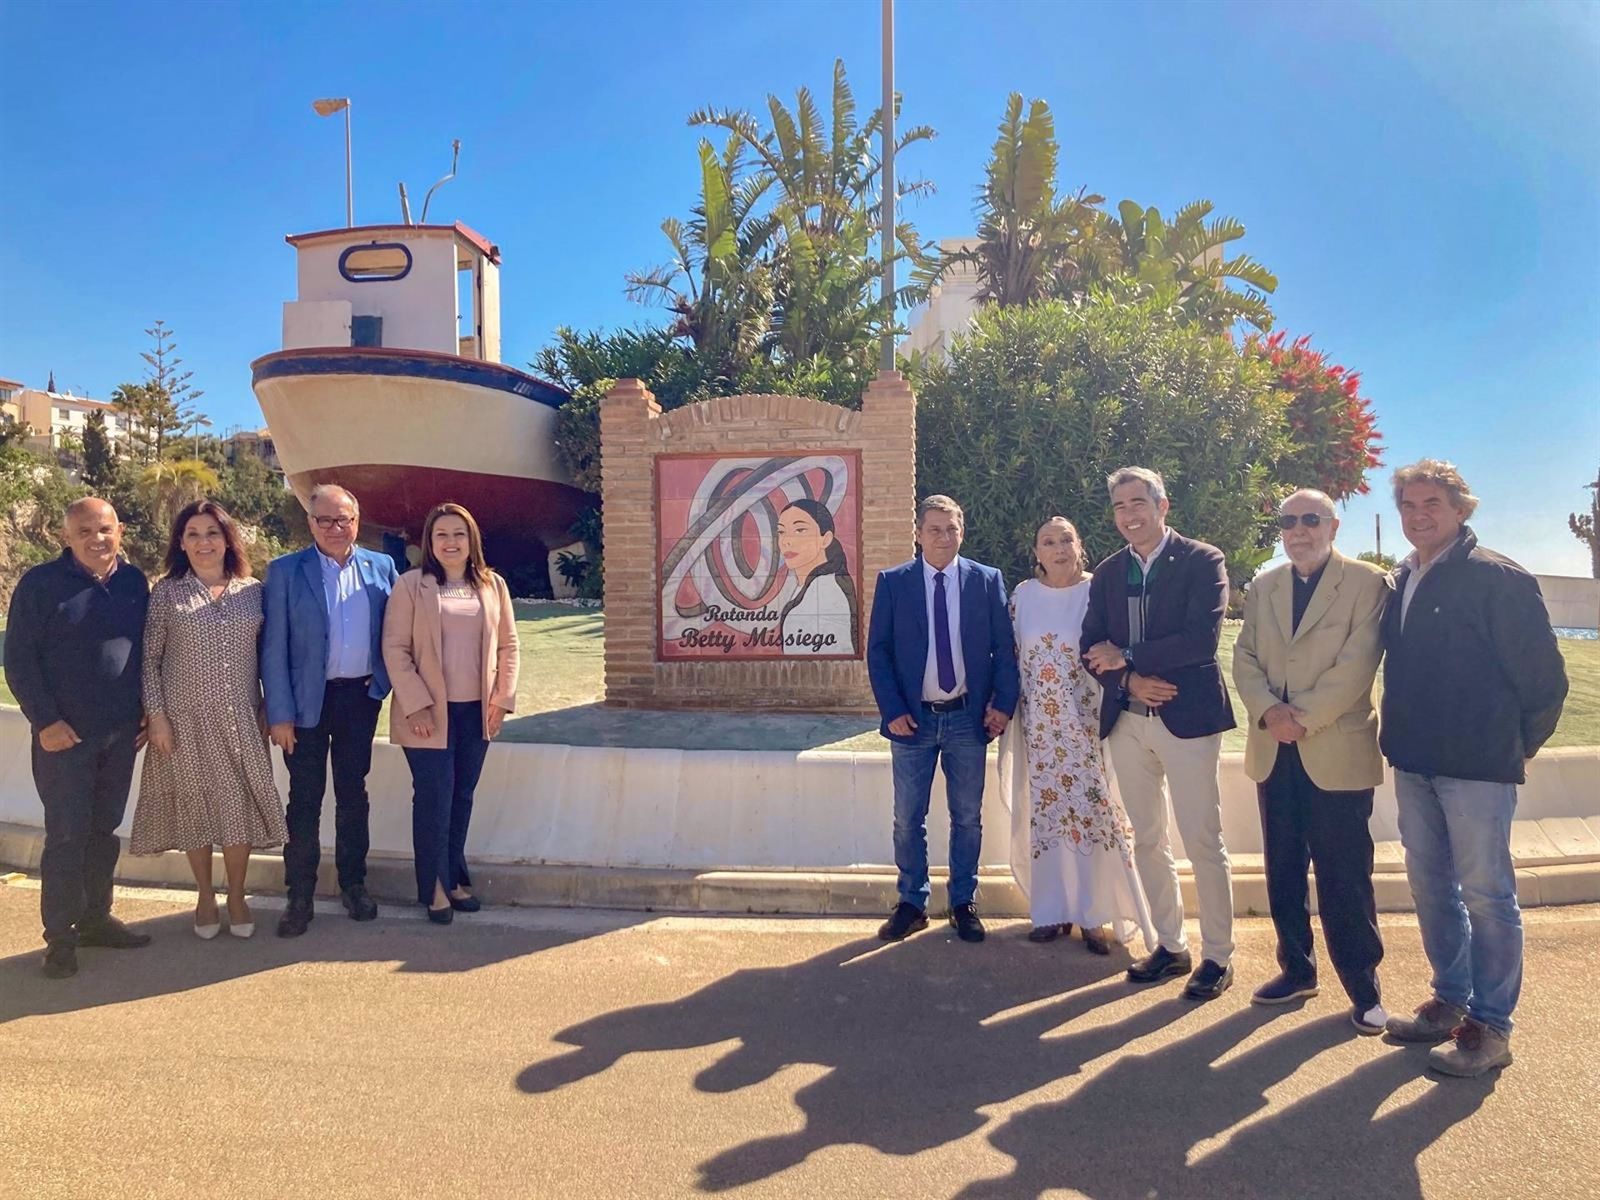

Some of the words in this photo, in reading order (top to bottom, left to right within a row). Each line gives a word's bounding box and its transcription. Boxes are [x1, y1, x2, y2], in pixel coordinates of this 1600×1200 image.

[703, 604, 779, 622] Rotonda
[679, 627, 737, 653] Betty
[742, 626, 837, 652] Missiego
